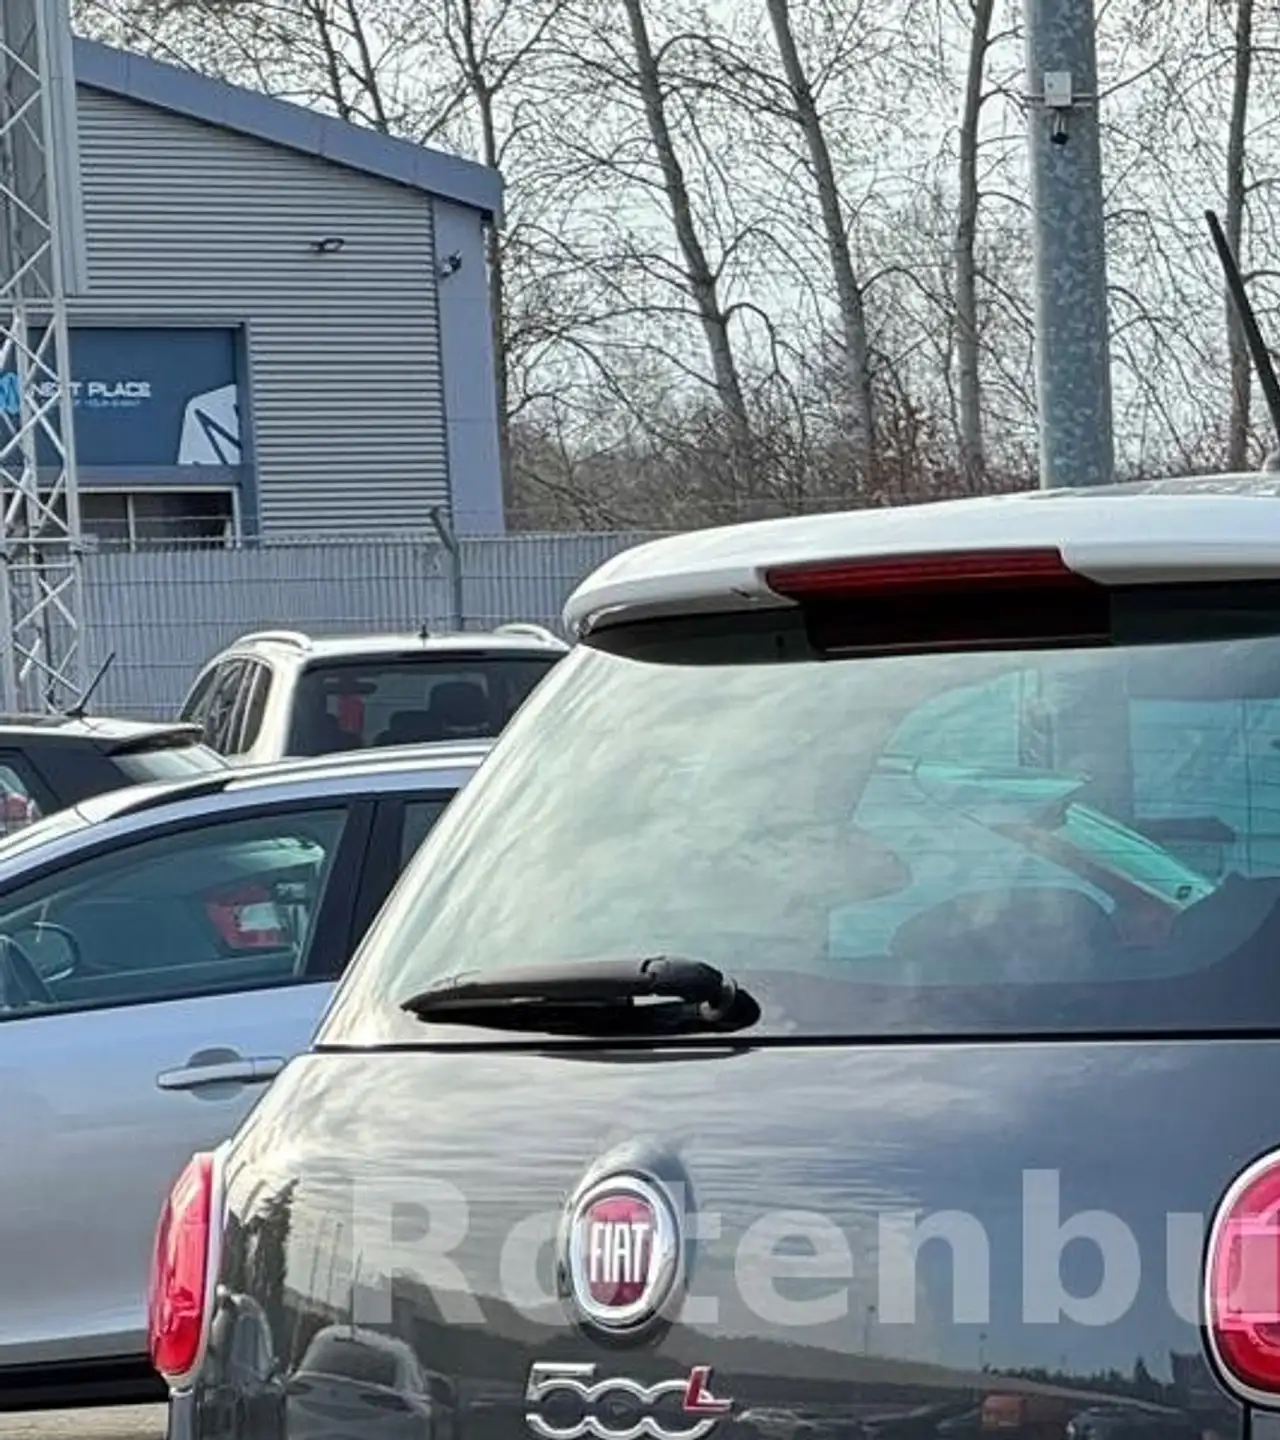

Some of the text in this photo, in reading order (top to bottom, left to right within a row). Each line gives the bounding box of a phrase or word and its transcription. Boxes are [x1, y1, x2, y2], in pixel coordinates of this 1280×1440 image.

[29, 381, 151, 398] NET PLACE
[589, 1221, 651, 1283] FIAT
